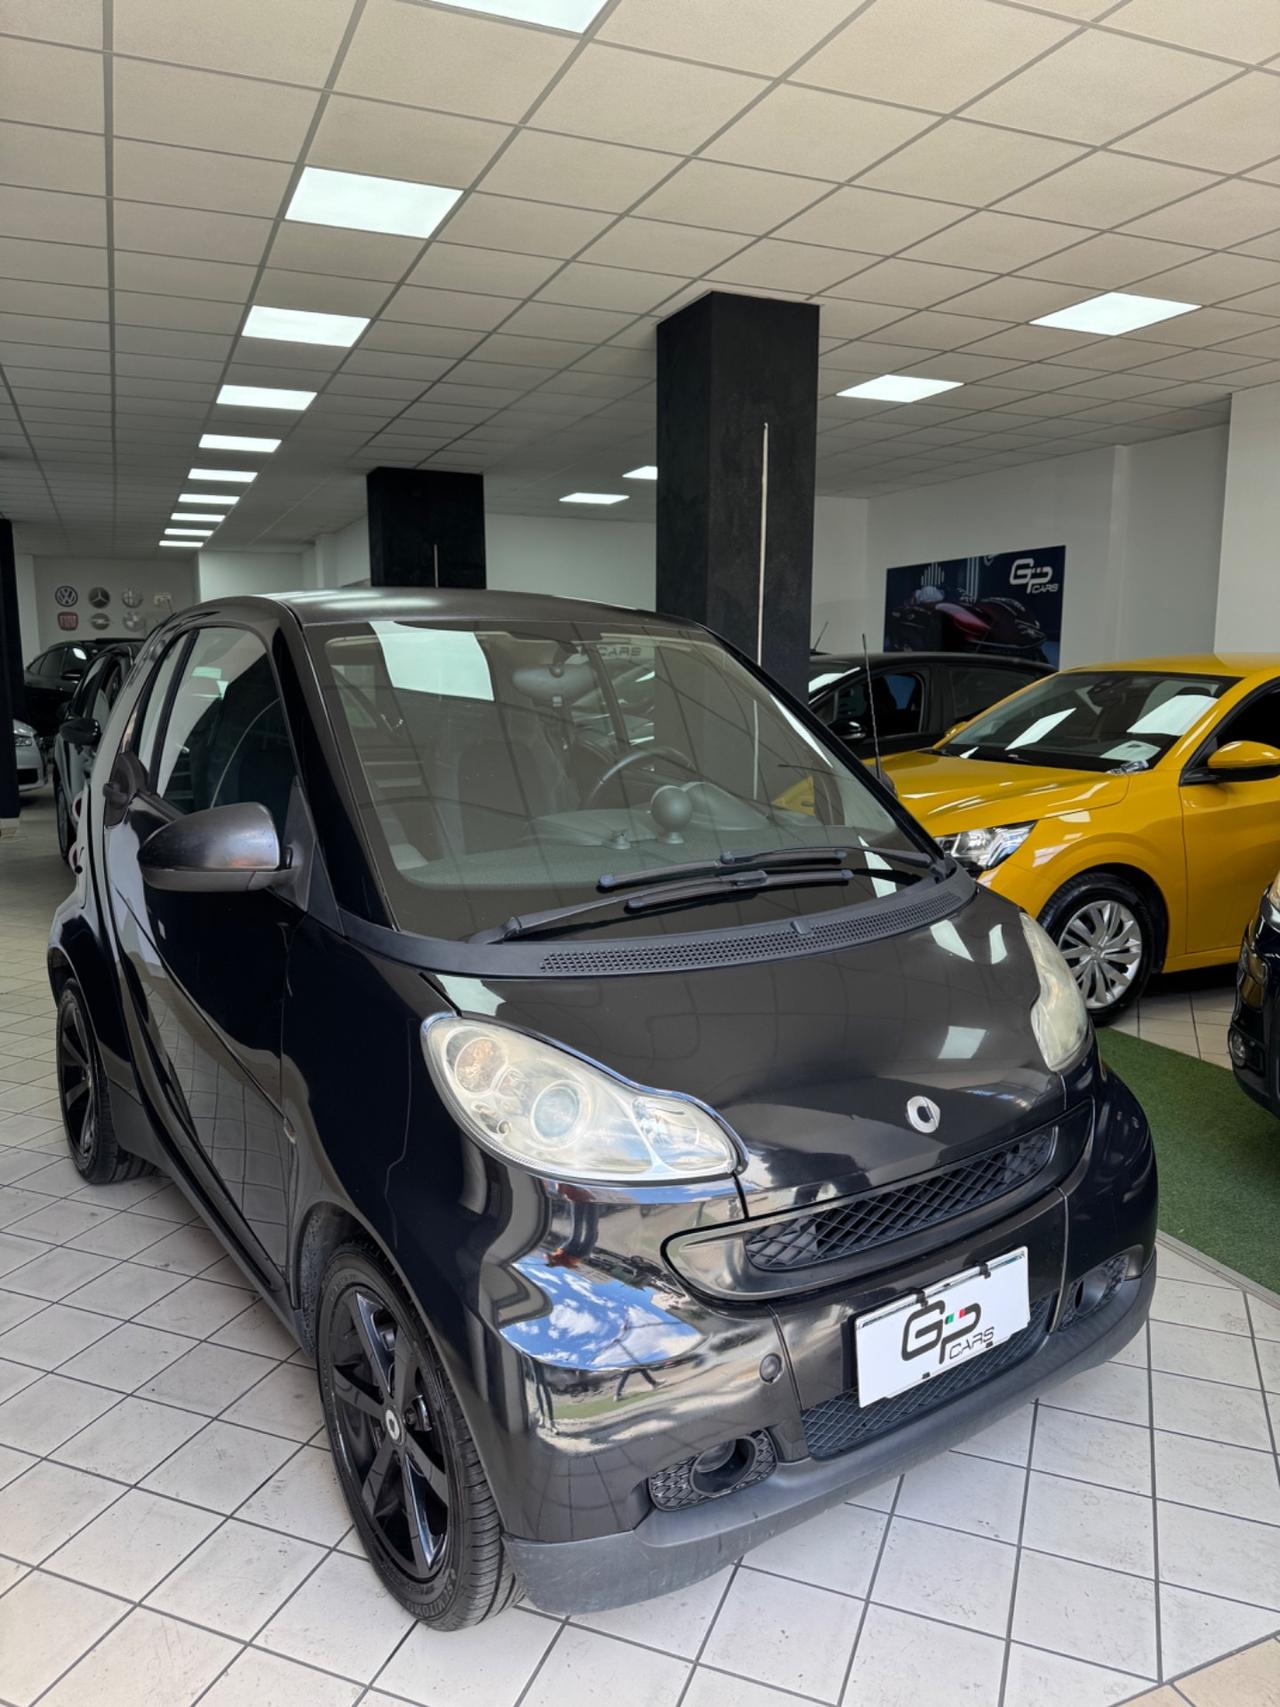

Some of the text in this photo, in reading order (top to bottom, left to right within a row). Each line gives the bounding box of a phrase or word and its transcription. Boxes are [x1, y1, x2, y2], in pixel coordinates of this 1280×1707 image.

[1032, 583, 1059, 594] CARS
[902, 1300, 981, 1364] GP
[949, 1326, 995, 1360] CARS
